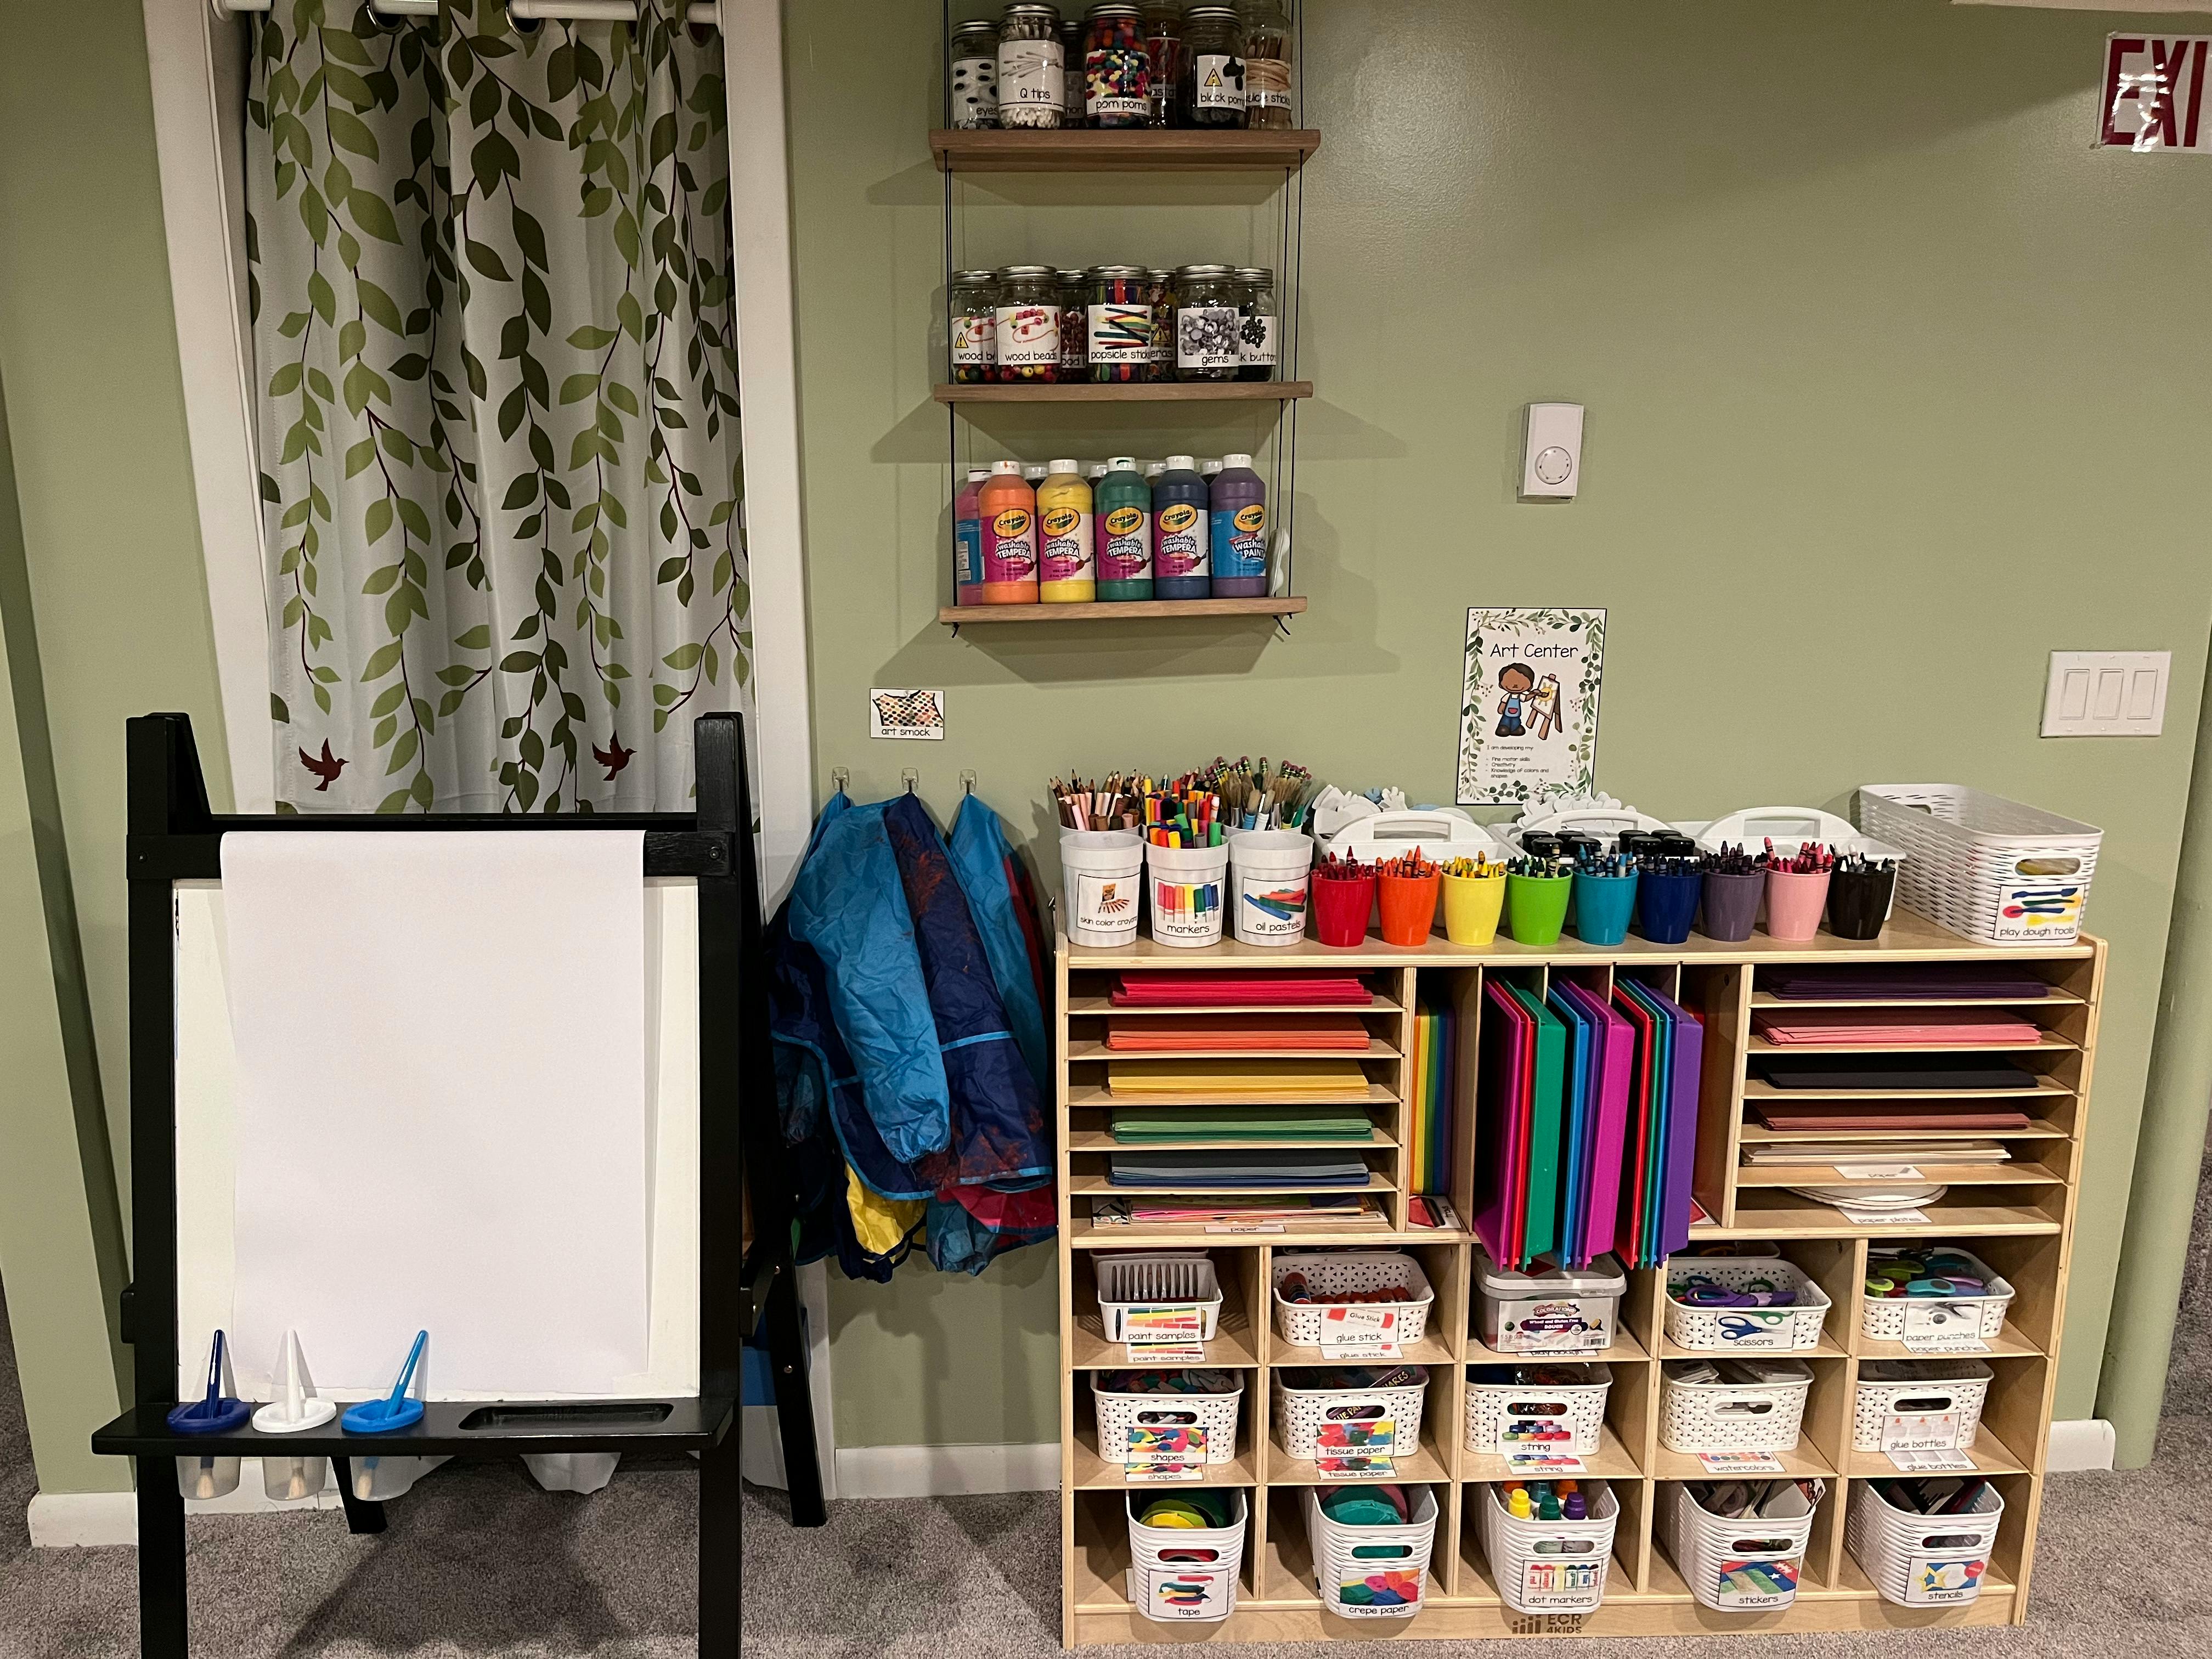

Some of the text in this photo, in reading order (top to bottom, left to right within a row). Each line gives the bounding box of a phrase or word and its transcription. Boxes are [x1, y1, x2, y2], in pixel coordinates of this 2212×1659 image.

[1020, 87, 1050, 101] Q tips
[1152, 86, 1174, 96] asta
[2101, 39, 2209, 147] EXI
[1200, 92, 1226, 103] black
[1246, 92, 1268, 103] sicle
[1096, 100, 1147, 111] pom poms
[976, 106, 997, 116] eyes
[958, 351, 983, 360] wood
[1005, 351, 1030, 361] wood
[1033, 351, 1057, 360] beads
[1091, 349, 1127, 364] popsicle
[1150, 349, 1173, 358] eras
[1250, 352, 1276, 362] butto
[1062, 355, 1080, 365] ood
[1201, 355, 1229, 368] gems
[998, 515, 1025, 526] Crayola
[1046, 513, 1073, 526] Crayola
[1110, 512, 1137, 524] Crayola
[1164, 510, 1190, 521] Crayola
[998, 540, 1029, 550] washable
[1046, 539, 1077, 550] washable
[1109, 539, 1141, 548] washable
[1163, 535, 1195, 545] washable
[1235, 538, 1265, 551] washa
[997, 548, 1031, 558] TEMPERA
[1046, 548, 1080, 558] TEMPERA
[1108, 548, 1142, 557] TEMPERA
[1162, 544, 1197, 553] TEMPERA
[1243, 549, 1264, 558] PAINT
[1489, 643, 1578, 658] Art Center
[900, 727, 930, 736] smock
[1080, 916, 1093, 925] skin
[1096, 917, 1116, 926] color
[1167, 924, 1210, 934] markers
[1255, 921, 1301, 933] oil pastels
[2000, 926, 2075, 937] play dough tools
[1536, 1306, 1576, 1314] COLORATIONS
[1128, 1331, 1196, 1341] paint samples
[1336, 1333, 1382, 1344] glue stick
[1733, 1337, 1774, 1347] scissors
[1944, 1345, 1987, 1353] punches
[1382, 1371, 1409, 1387] ARES
[1521, 1443, 1550, 1452] string
[1891, 1439, 1947, 1450] glue bottles
[1325, 1446, 1385, 1457] tissue paper
[1151, 1453, 1185, 1463] shapes
[1713, 1463, 1775, 1471] watercolors
[1358, 1470, 1387, 1479] paper
[1738, 1594, 1778, 1605] stickers
[1927, 1589, 1963, 1600] stencils
[1177, 1606, 1200, 1617] tape
[1348, 1603, 1409, 1616] crepe paper
[1548, 1613, 1582, 1625] ECR
